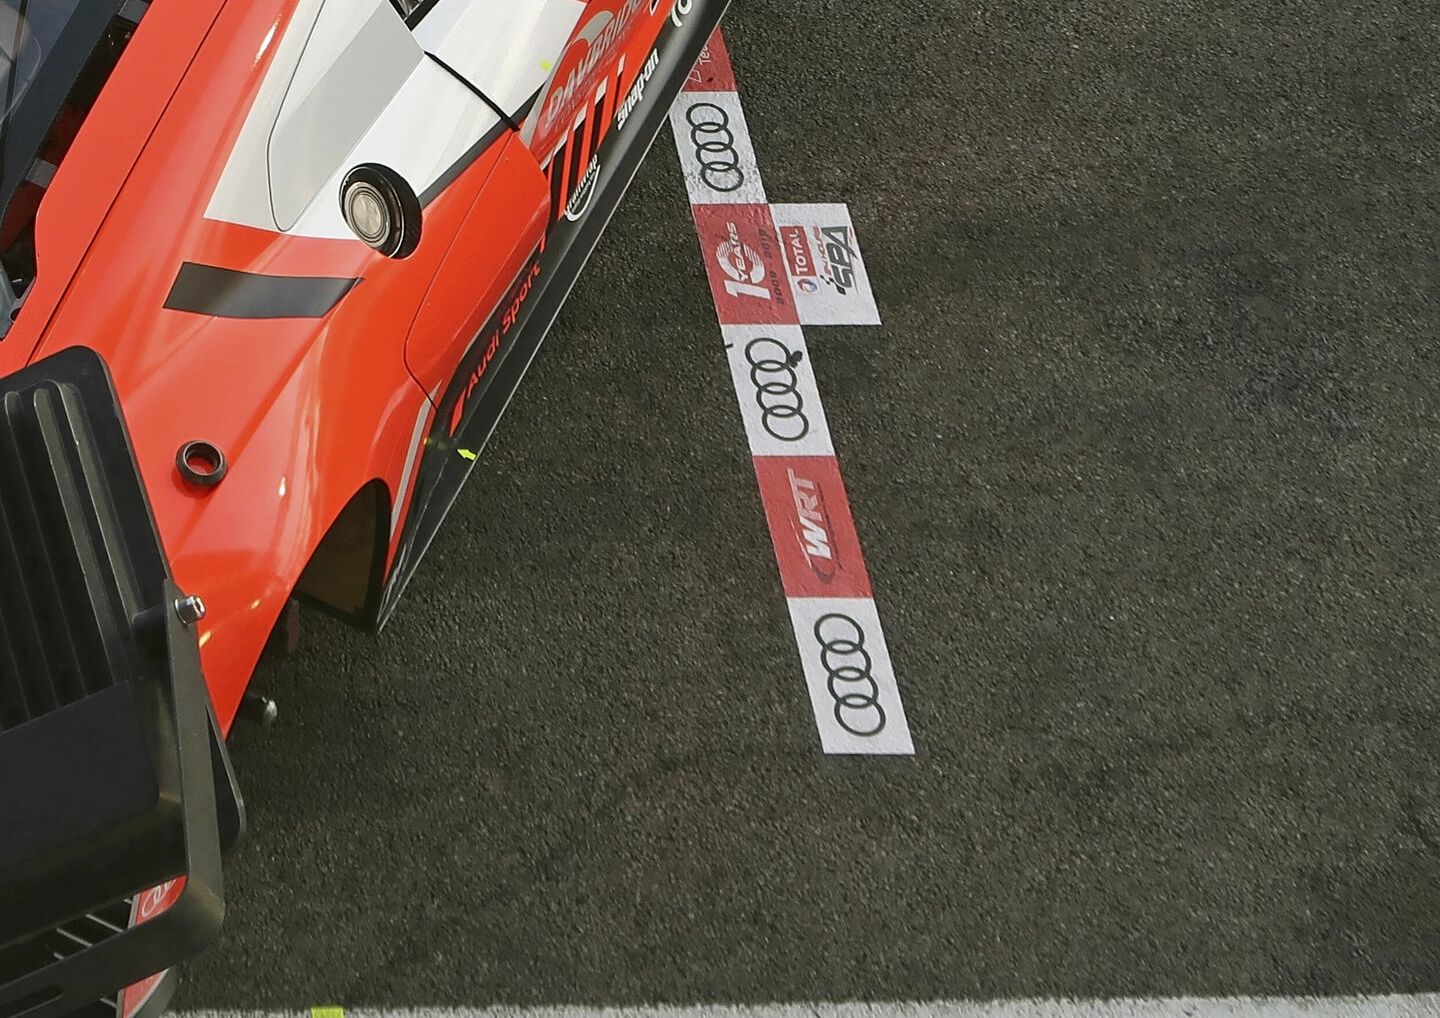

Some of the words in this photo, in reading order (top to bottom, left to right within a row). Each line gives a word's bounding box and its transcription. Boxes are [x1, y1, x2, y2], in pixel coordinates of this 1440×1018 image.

[617, 49, 659, 130] snap-on
[726, 222, 748, 281] YEARS
[789, 228, 809, 275] TOTAL
[820, 226, 858, 288] SPA
[468, 329, 500, 398] Audi
[502, 259, 541, 334] Sport
[786, 467, 833, 560] WRT
